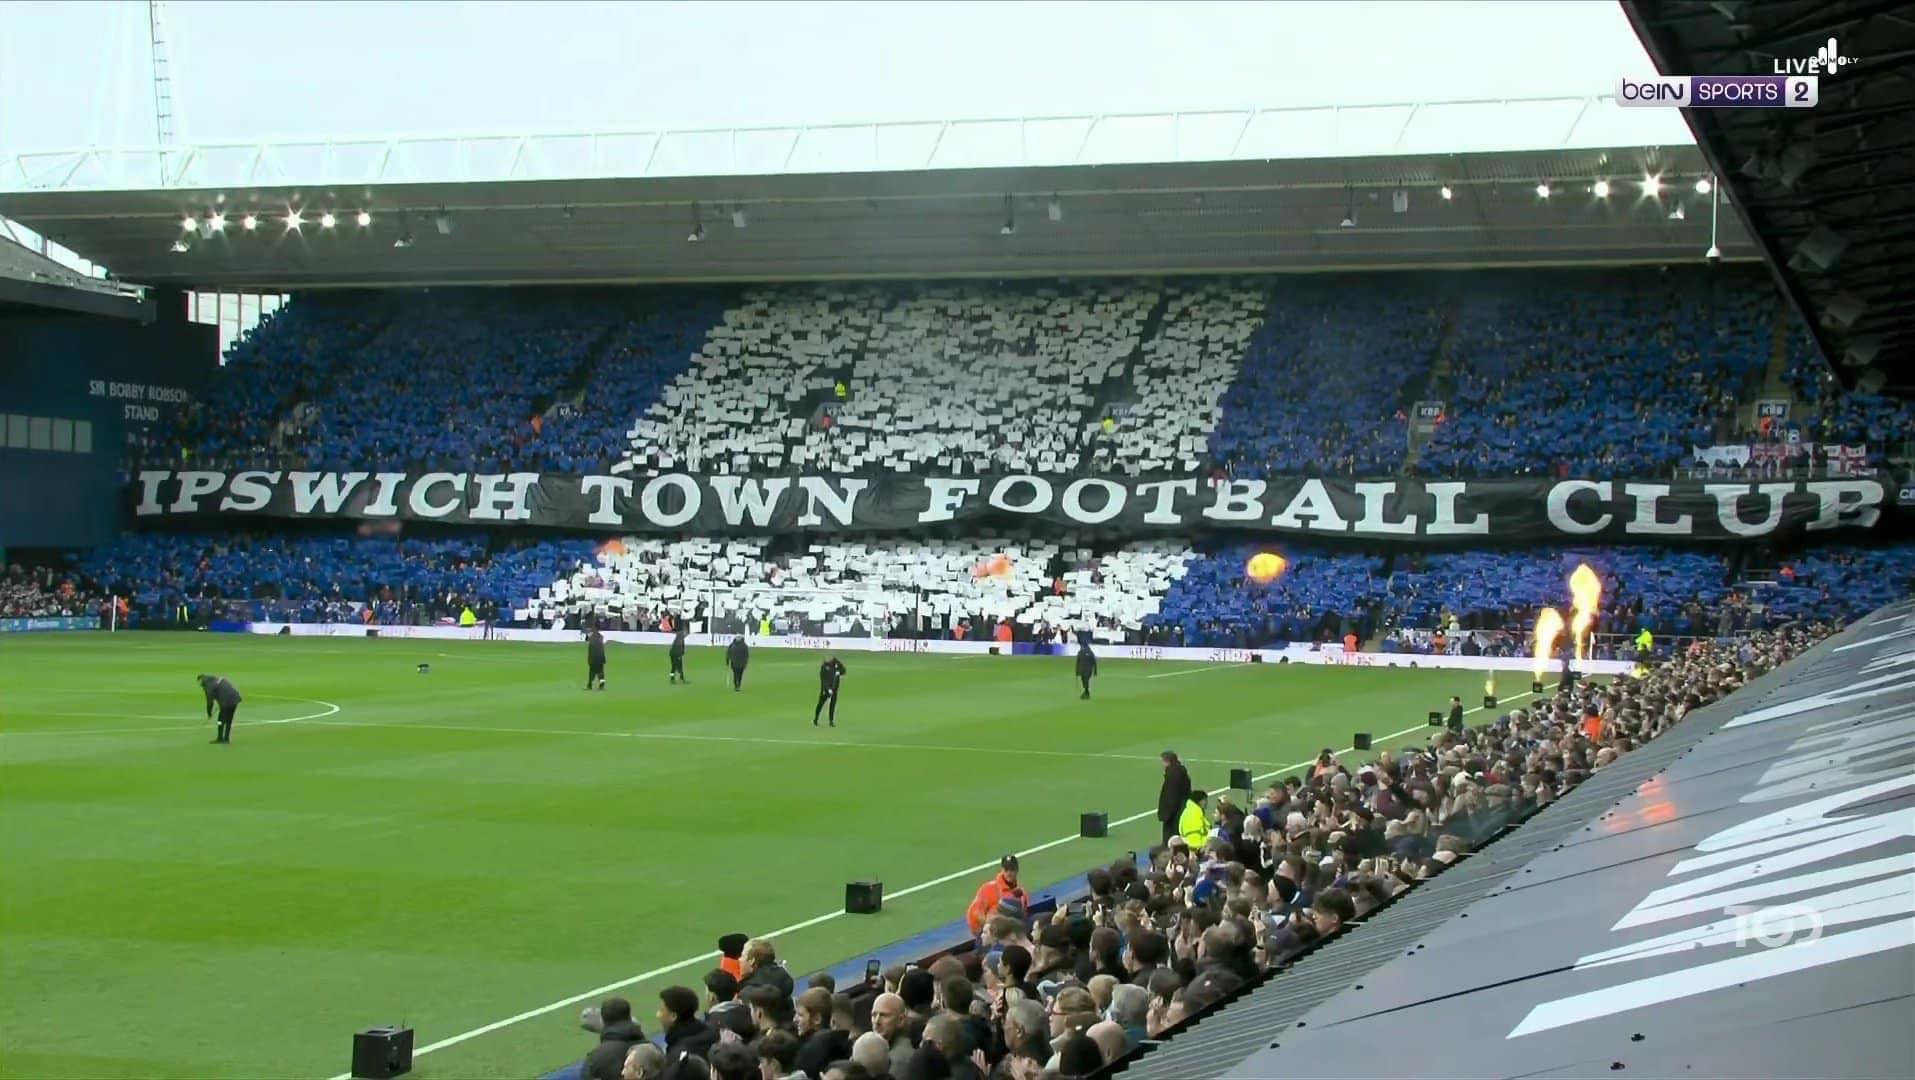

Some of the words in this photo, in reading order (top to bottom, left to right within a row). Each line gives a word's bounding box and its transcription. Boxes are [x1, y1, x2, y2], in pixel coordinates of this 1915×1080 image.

[89, 380, 105, 396] SIR
[109, 382, 145, 399] BOBBY
[124, 405, 159, 421] STAND
[136, 470, 540, 520] IPSWICH
[580, 473, 868, 528] TOWN
[917, 474, 1490, 536] FOOTBALL
[1545, 478, 1886, 537] CLUB
